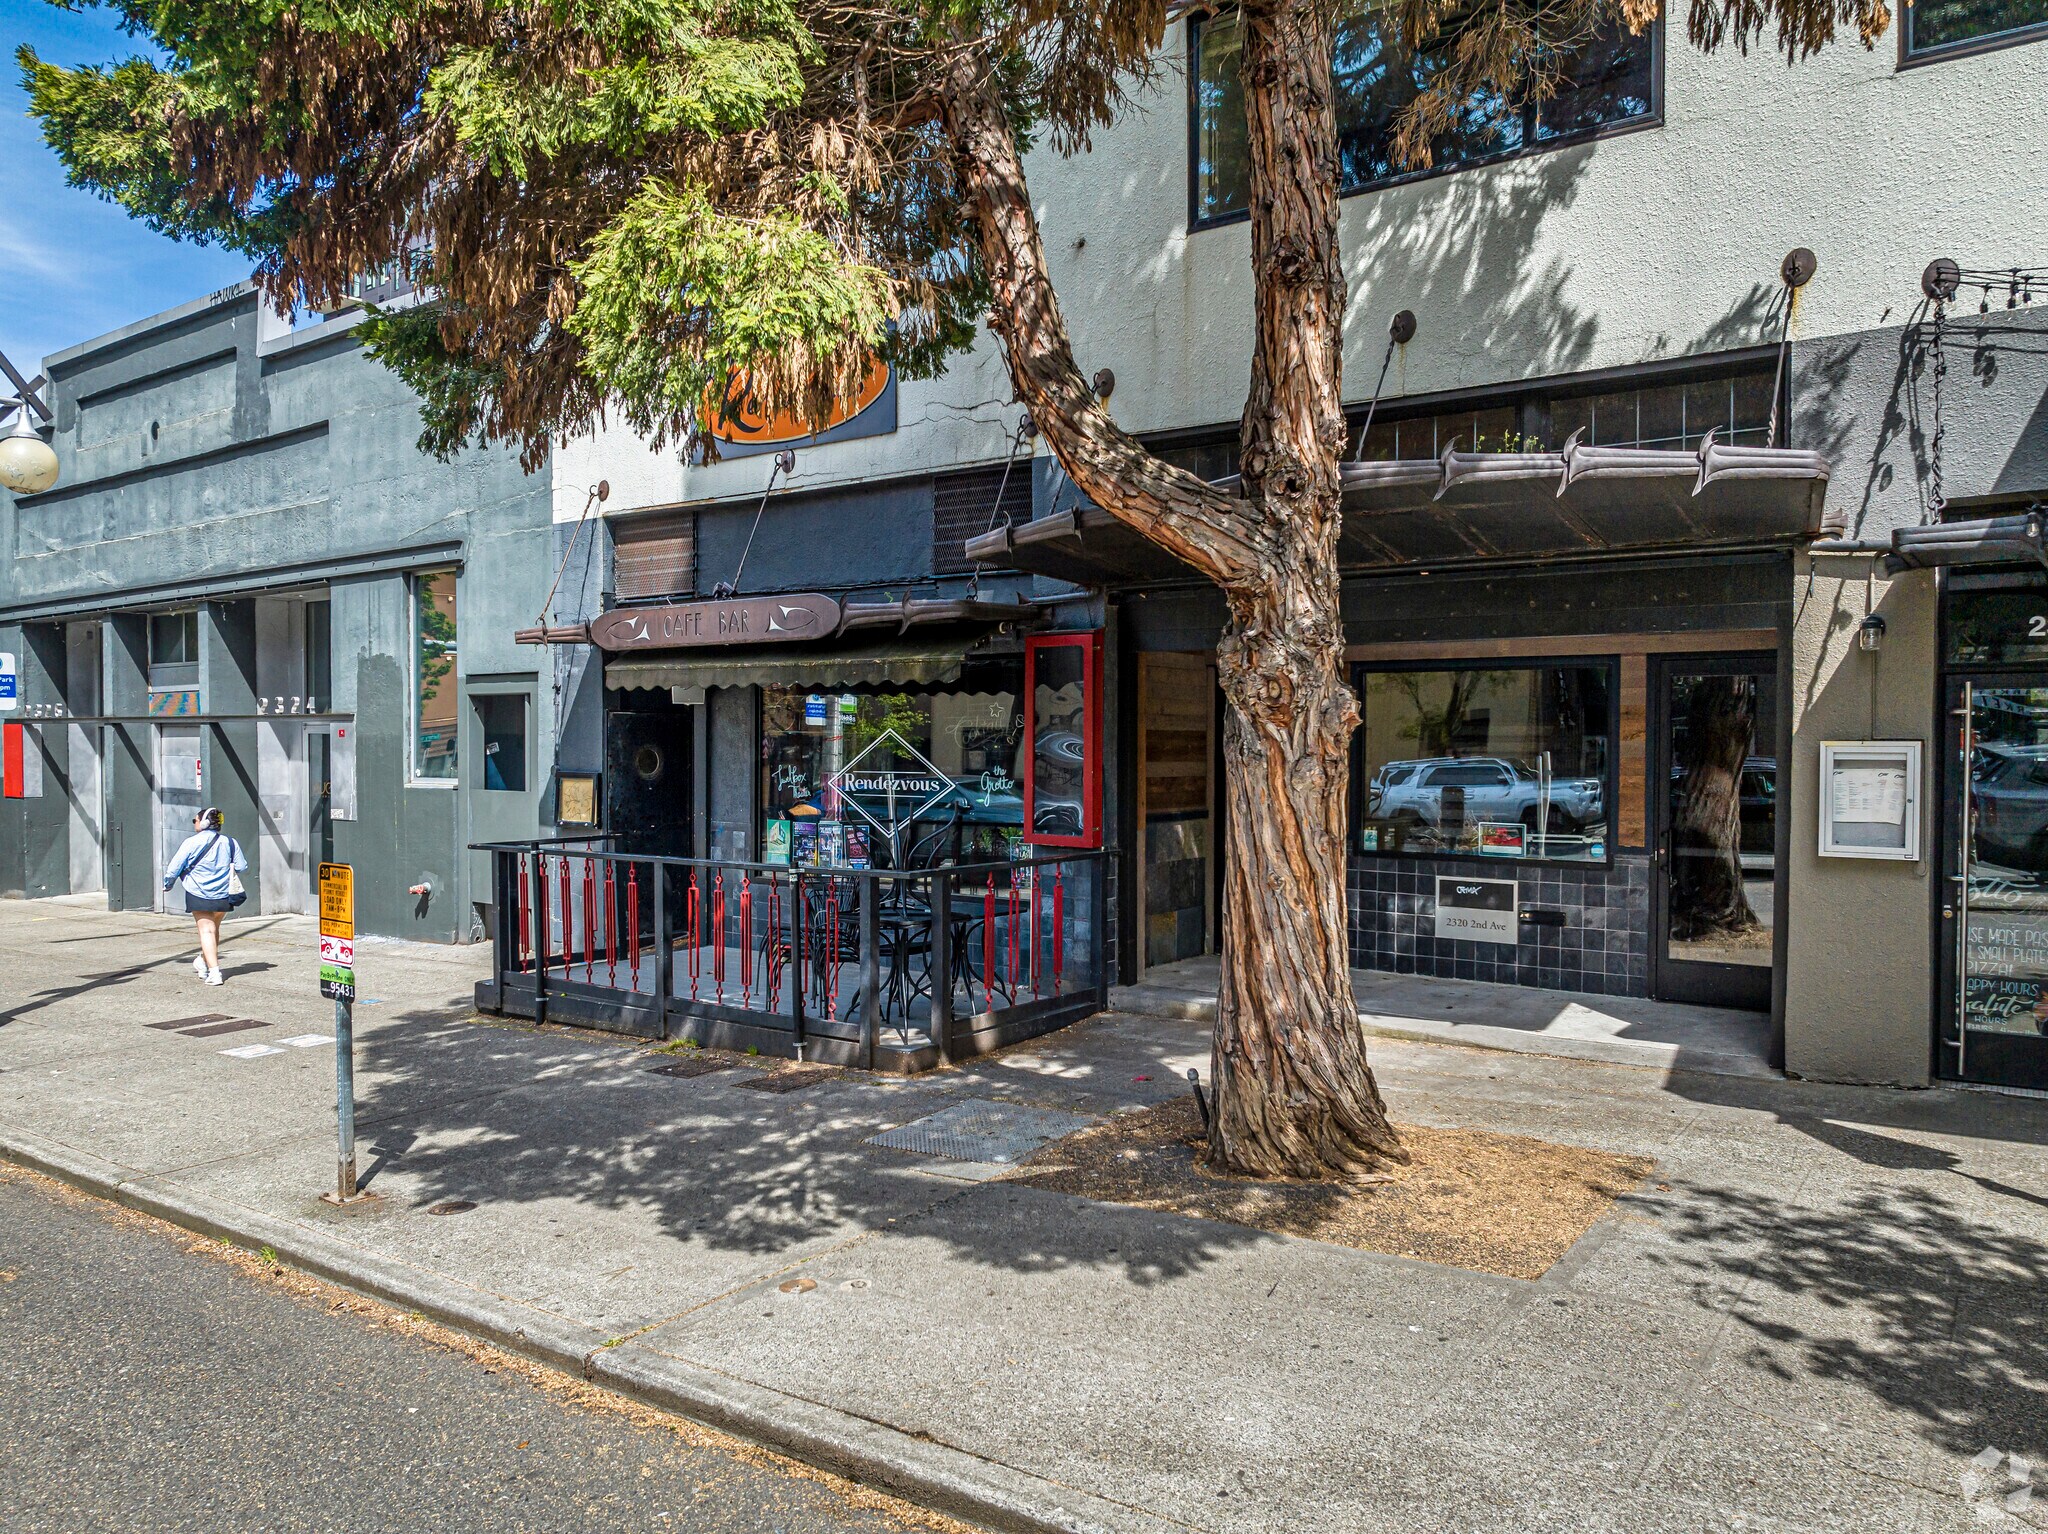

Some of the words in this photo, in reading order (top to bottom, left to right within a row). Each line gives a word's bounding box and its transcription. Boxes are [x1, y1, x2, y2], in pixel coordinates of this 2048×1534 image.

[664, 613, 702, 638] CAFE
[719, 609, 749, 634] BAR
[2028, 615, 2048, 637] 2
[258, 696, 316, 715] 2324
[844, 773, 940, 792] Rendezvous
[980, 771, 1015, 807] Grotto
[320, 867, 330, 878] 30
[331, 870, 350, 881] MNUTE
[1446, 918, 1468, 928] 2320
[1470, 919, 1487, 929] 2nd
[1489, 921, 1506, 931] Ave
[1988, 928, 2021, 947] MADE
[1978, 945, 2007, 961] SMALL
[2013, 947, 2048, 964] PLATE
[1966, 961, 2014, 977] PIZZA!
[330, 981, 355, 998] 95431
[2000, 981, 2040, 997] HOURS
[1974, 1015, 2008, 1026] HOURS
